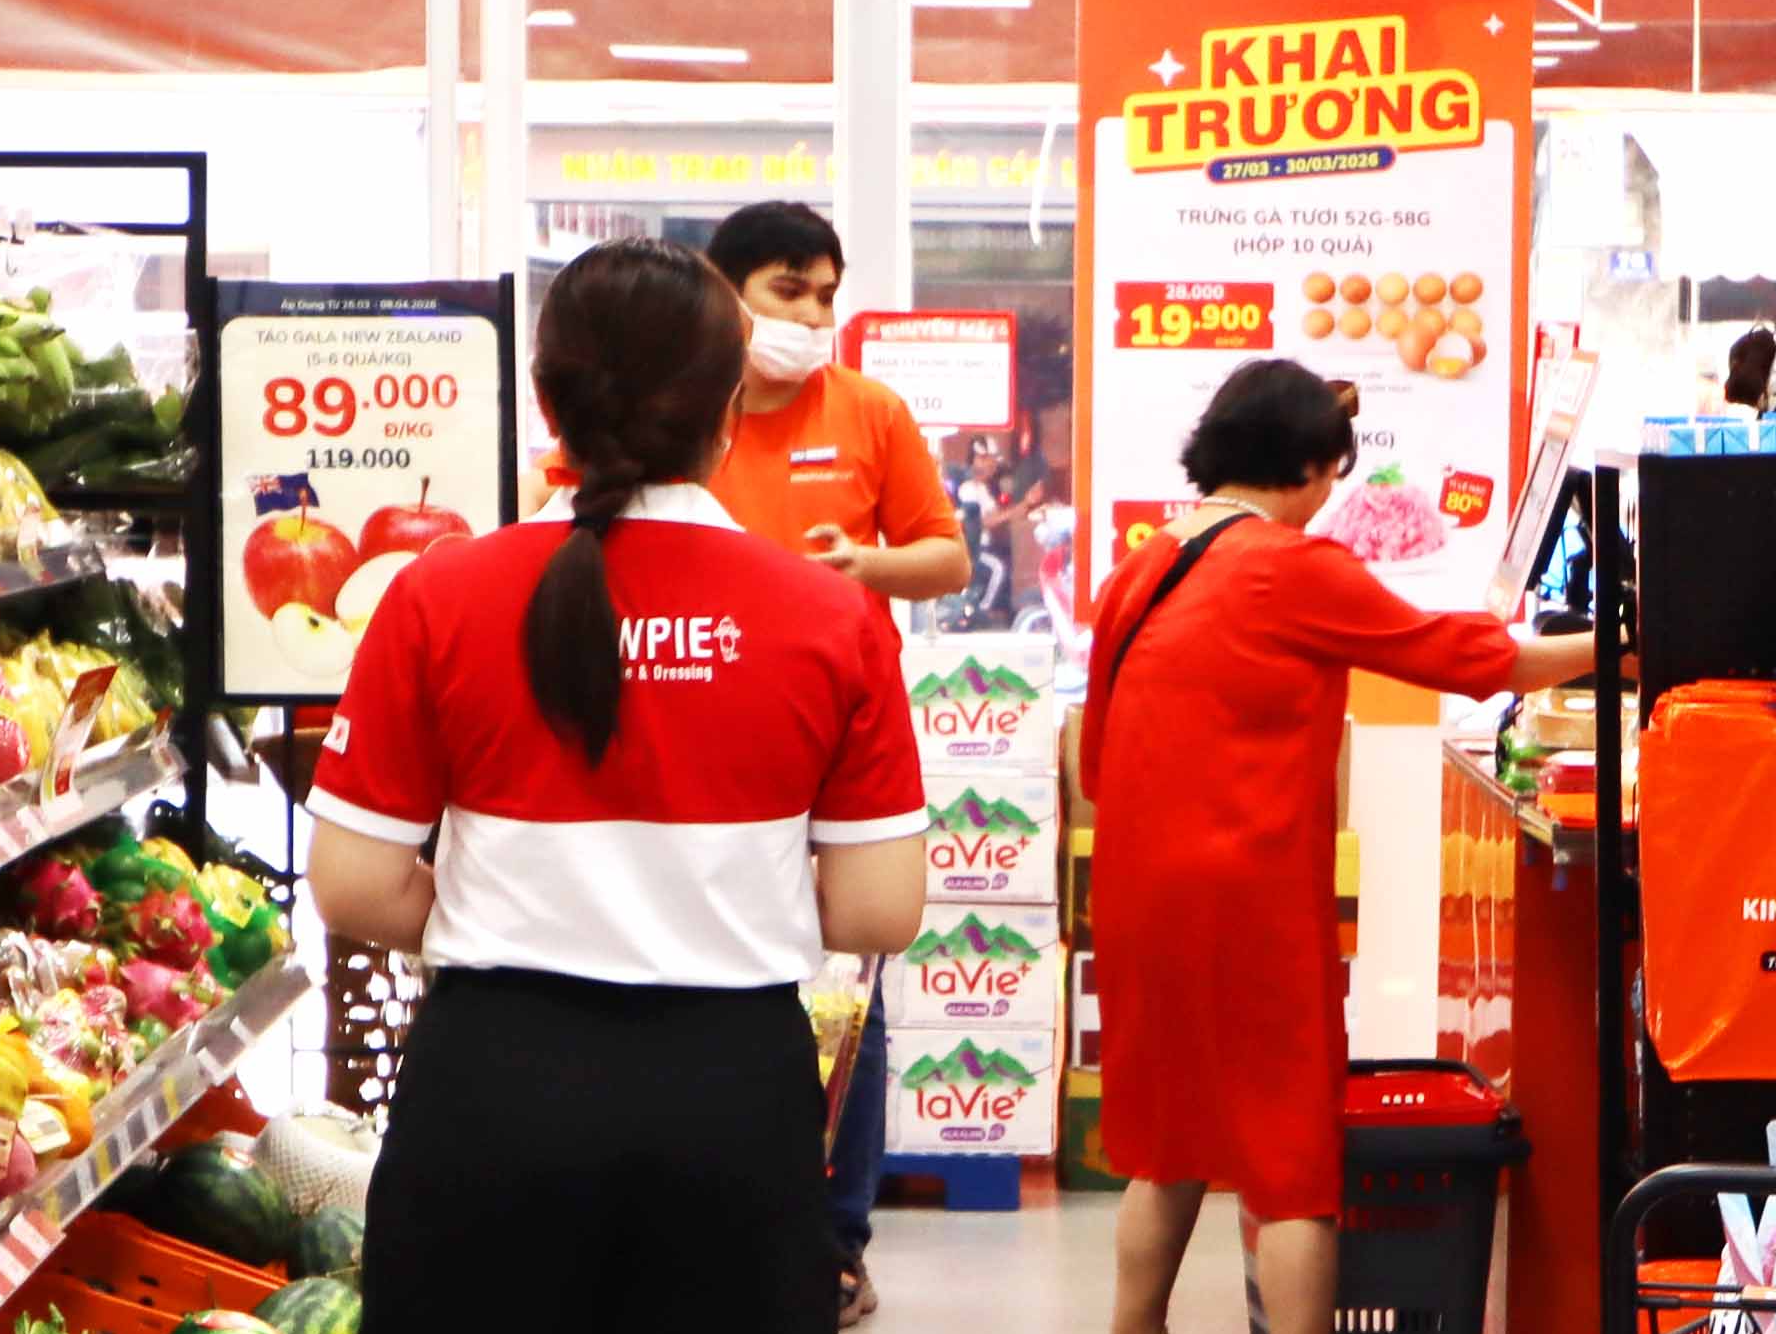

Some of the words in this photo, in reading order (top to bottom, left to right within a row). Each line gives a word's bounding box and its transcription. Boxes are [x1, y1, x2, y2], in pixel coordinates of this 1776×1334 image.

[1210, 26, 1397, 89] KHAI
[1133, 80, 1471, 154] TRƯƠNG
[1293, 239, 1314, 254] 10
[293, 331, 338, 344] GALA
[342, 331, 380, 344] NEW
[386, 330, 462, 344] ZEALAND
[1130, 304, 1260, 345] 19.900
[262, 374, 459, 438] 89.000
[306, 449, 411, 469] 119.000
[1446, 493, 1483, 513] 80%
[619, 616, 714, 662] WPIE
[654, 665, 713, 683] Dressing
